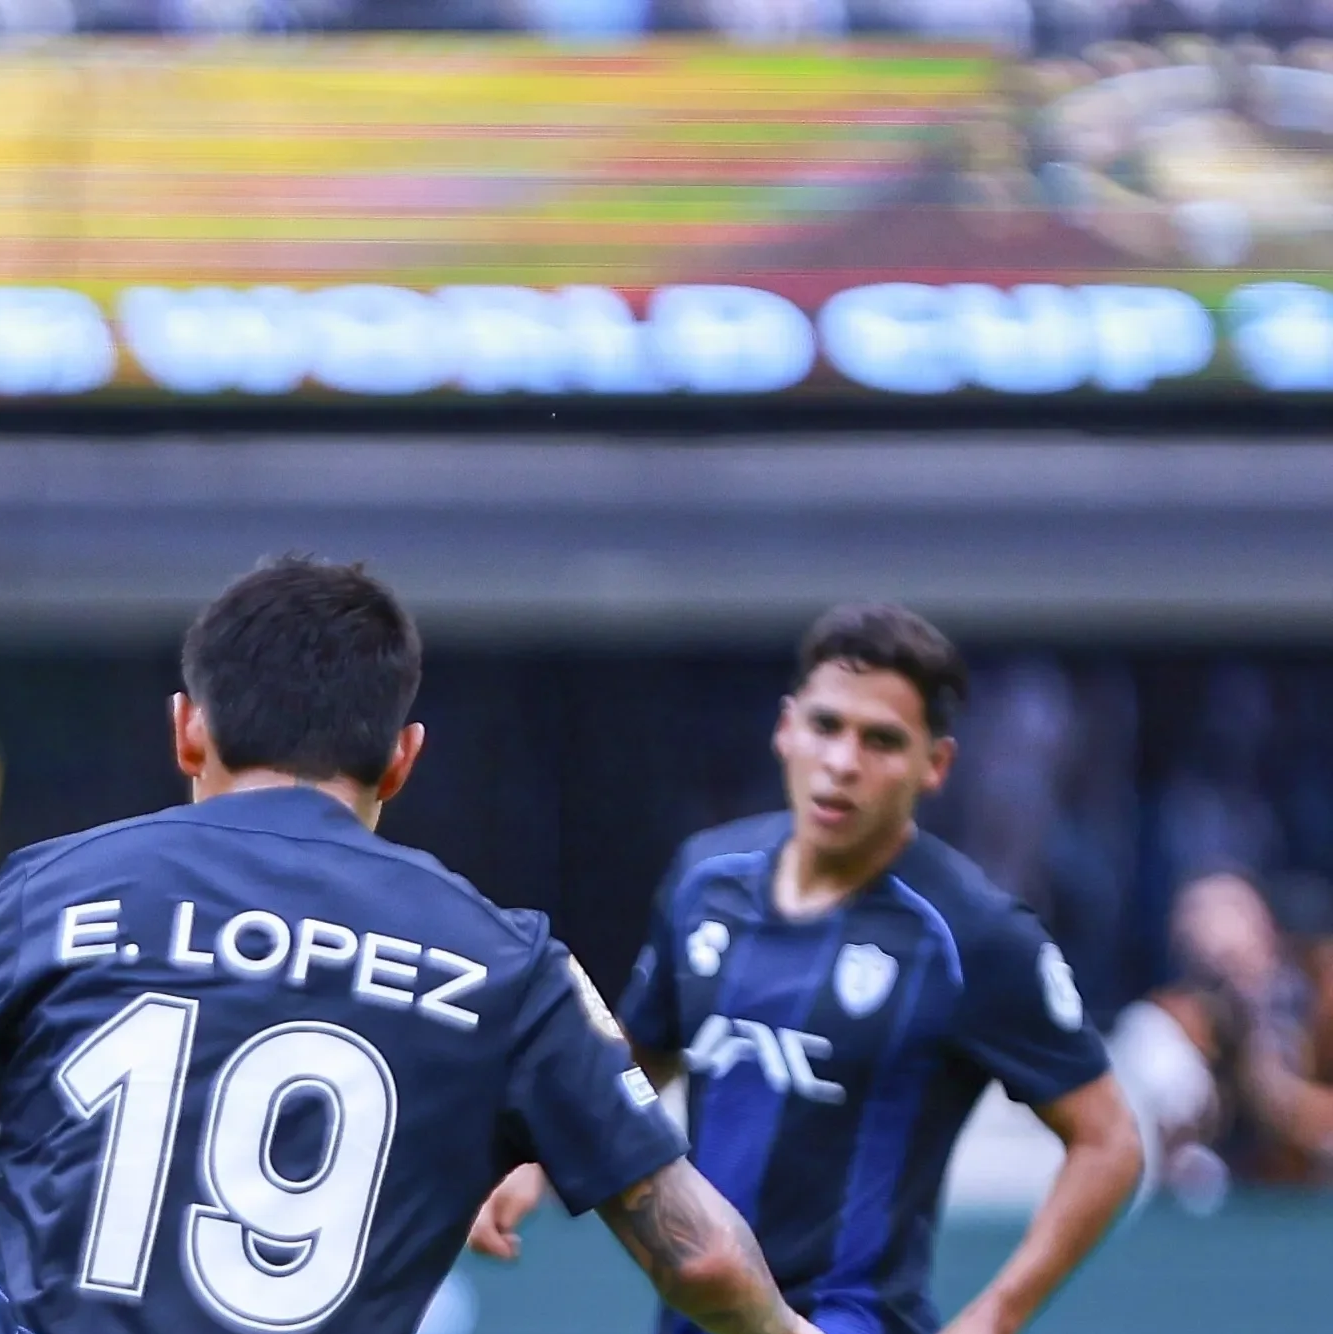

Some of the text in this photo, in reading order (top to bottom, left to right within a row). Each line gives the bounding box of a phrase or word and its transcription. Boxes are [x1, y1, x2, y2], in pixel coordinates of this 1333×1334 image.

[61, 900, 487, 1027] E. LOPEZ
[58, 992, 397, 1332] 19
